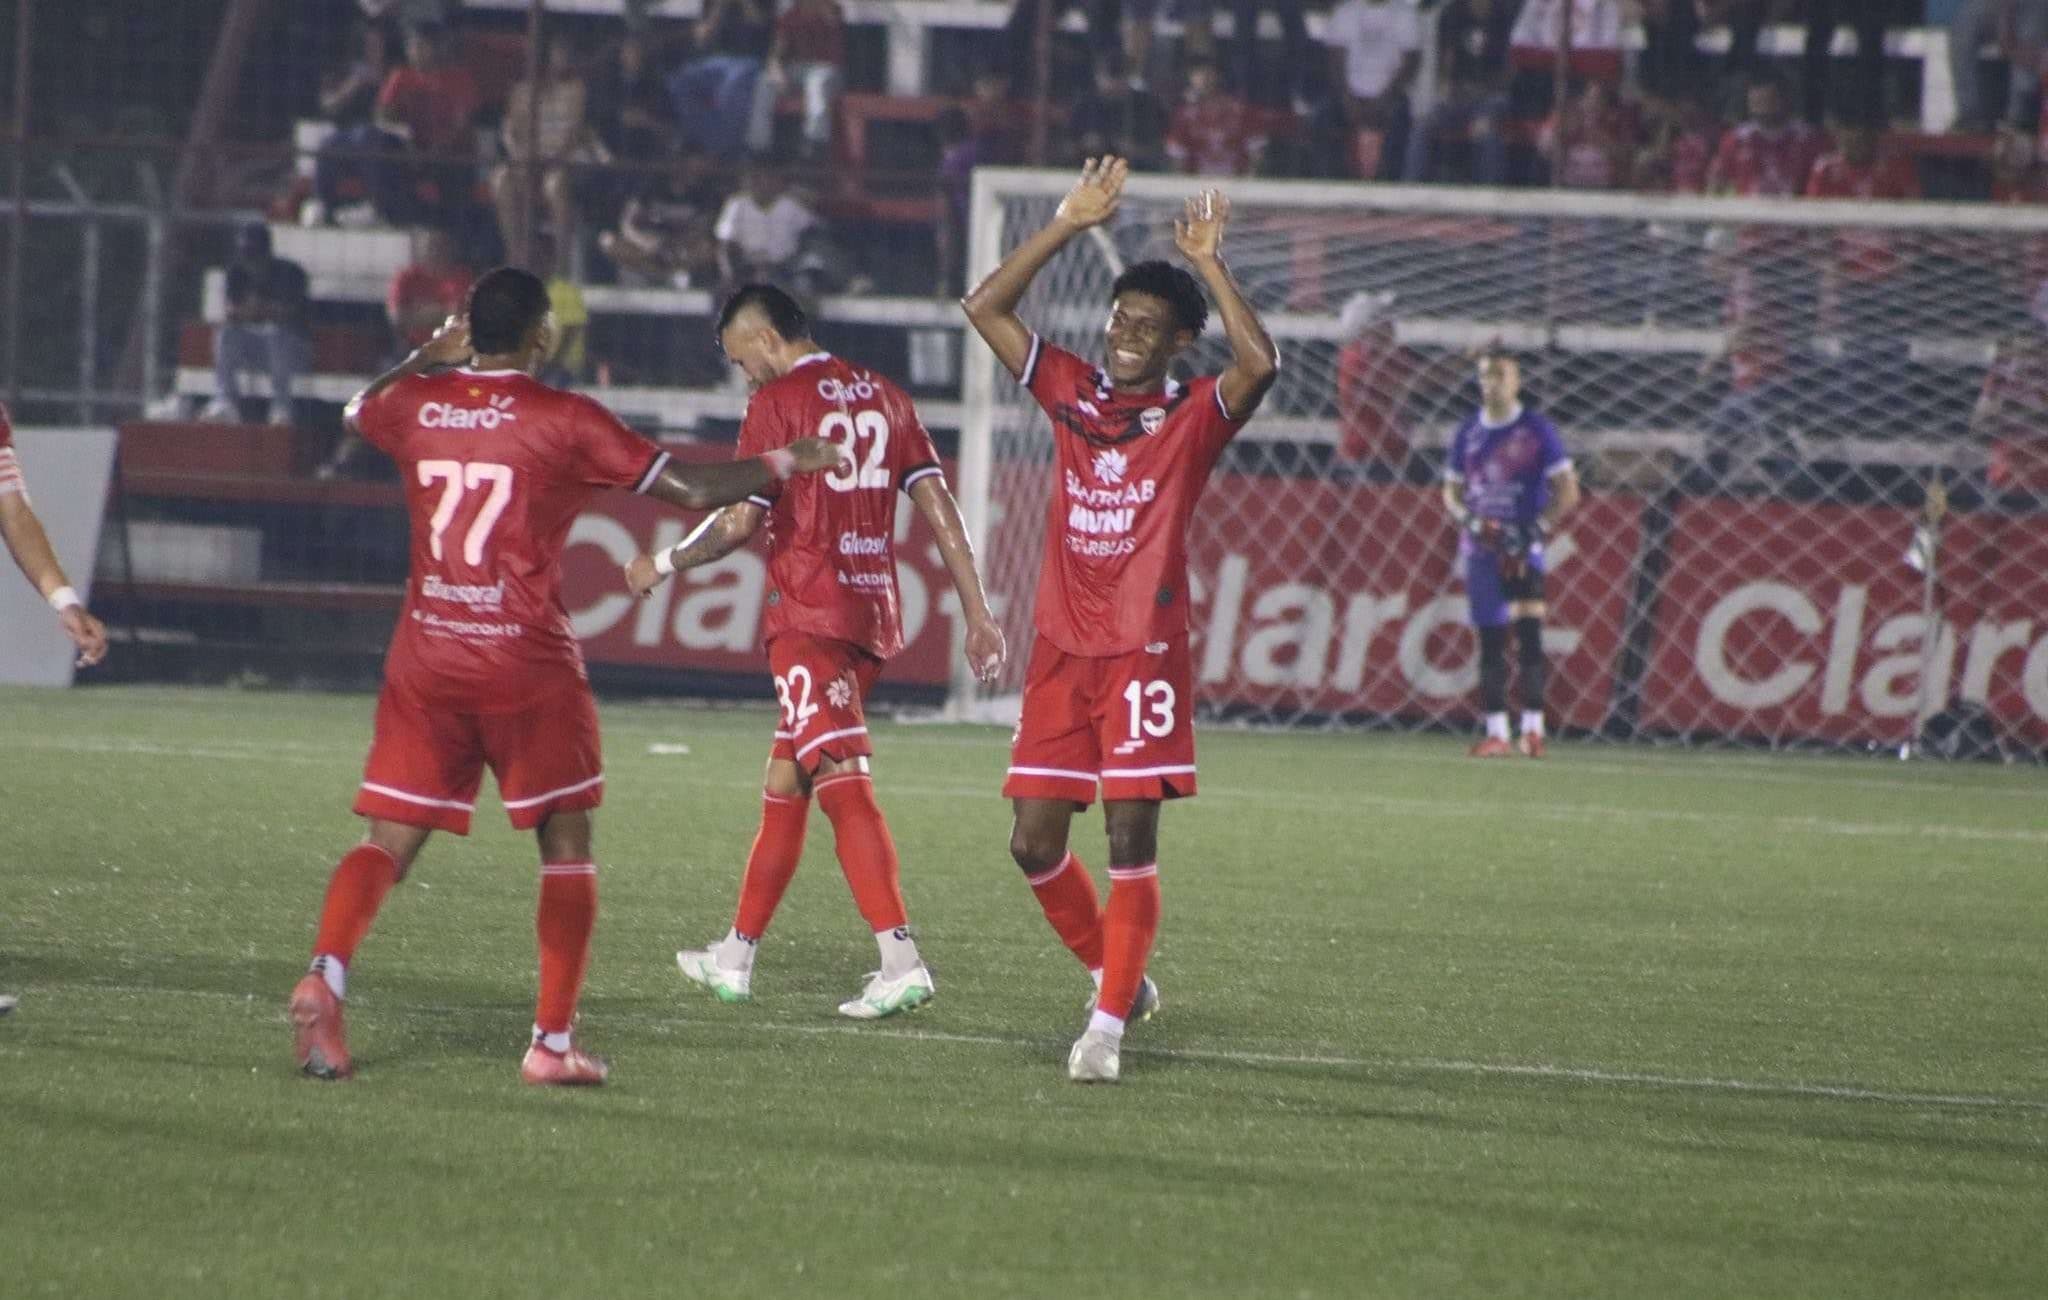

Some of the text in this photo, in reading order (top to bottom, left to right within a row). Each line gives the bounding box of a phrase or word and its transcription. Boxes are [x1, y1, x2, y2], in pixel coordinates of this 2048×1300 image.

[418, 401, 501, 429] Claro
[818, 410, 890, 492] 32
[417, 459, 513, 567] 77
[562, 513, 928, 655] Cla
[1188, 553, 1482, 697] laro
[774, 664, 819, 726] 32
[1695, 579, 2048, 718] Clar
[1123, 679, 1176, 738] 13
